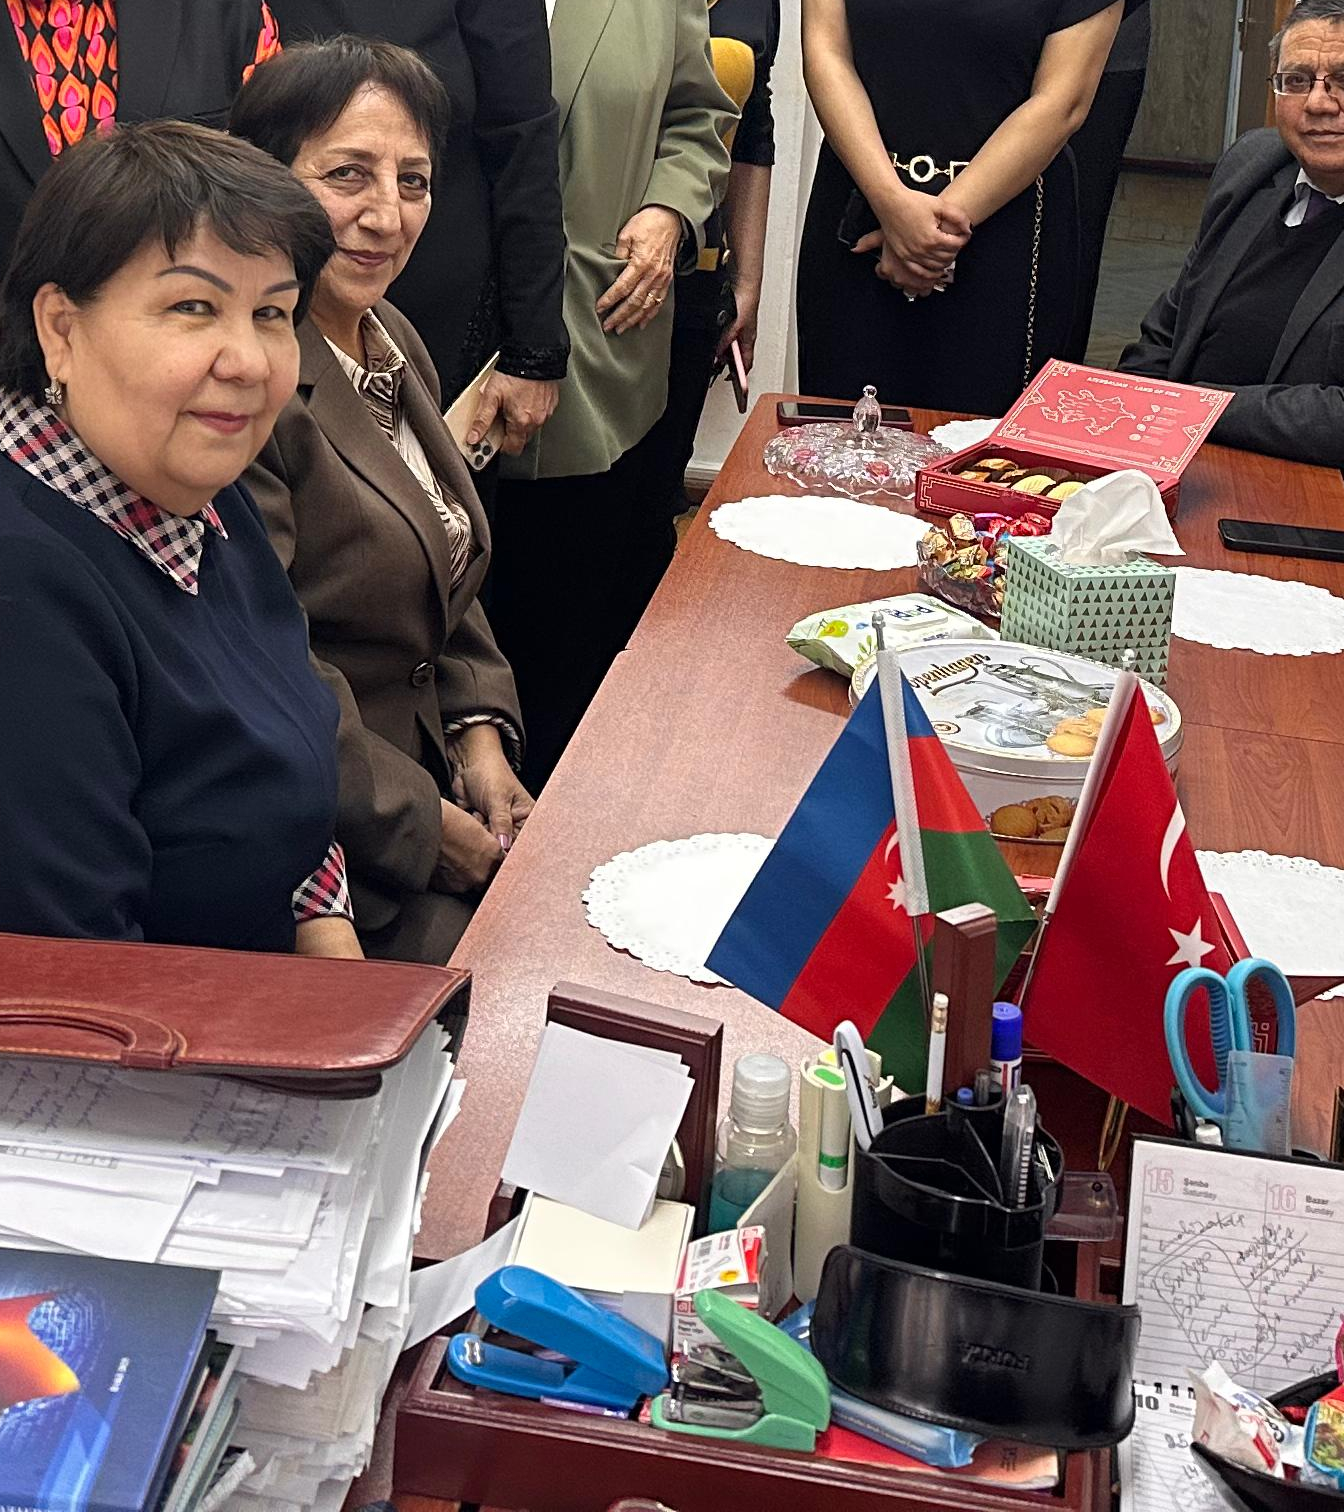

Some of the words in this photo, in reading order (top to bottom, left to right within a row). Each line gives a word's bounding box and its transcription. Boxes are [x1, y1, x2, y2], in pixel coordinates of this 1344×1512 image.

[1134, 385, 1152, 393] LAND
[909, 653, 992, 696] openhagen
[1147, 1166, 1175, 1195] 15
[1269, 1184, 1297, 1212] 16
